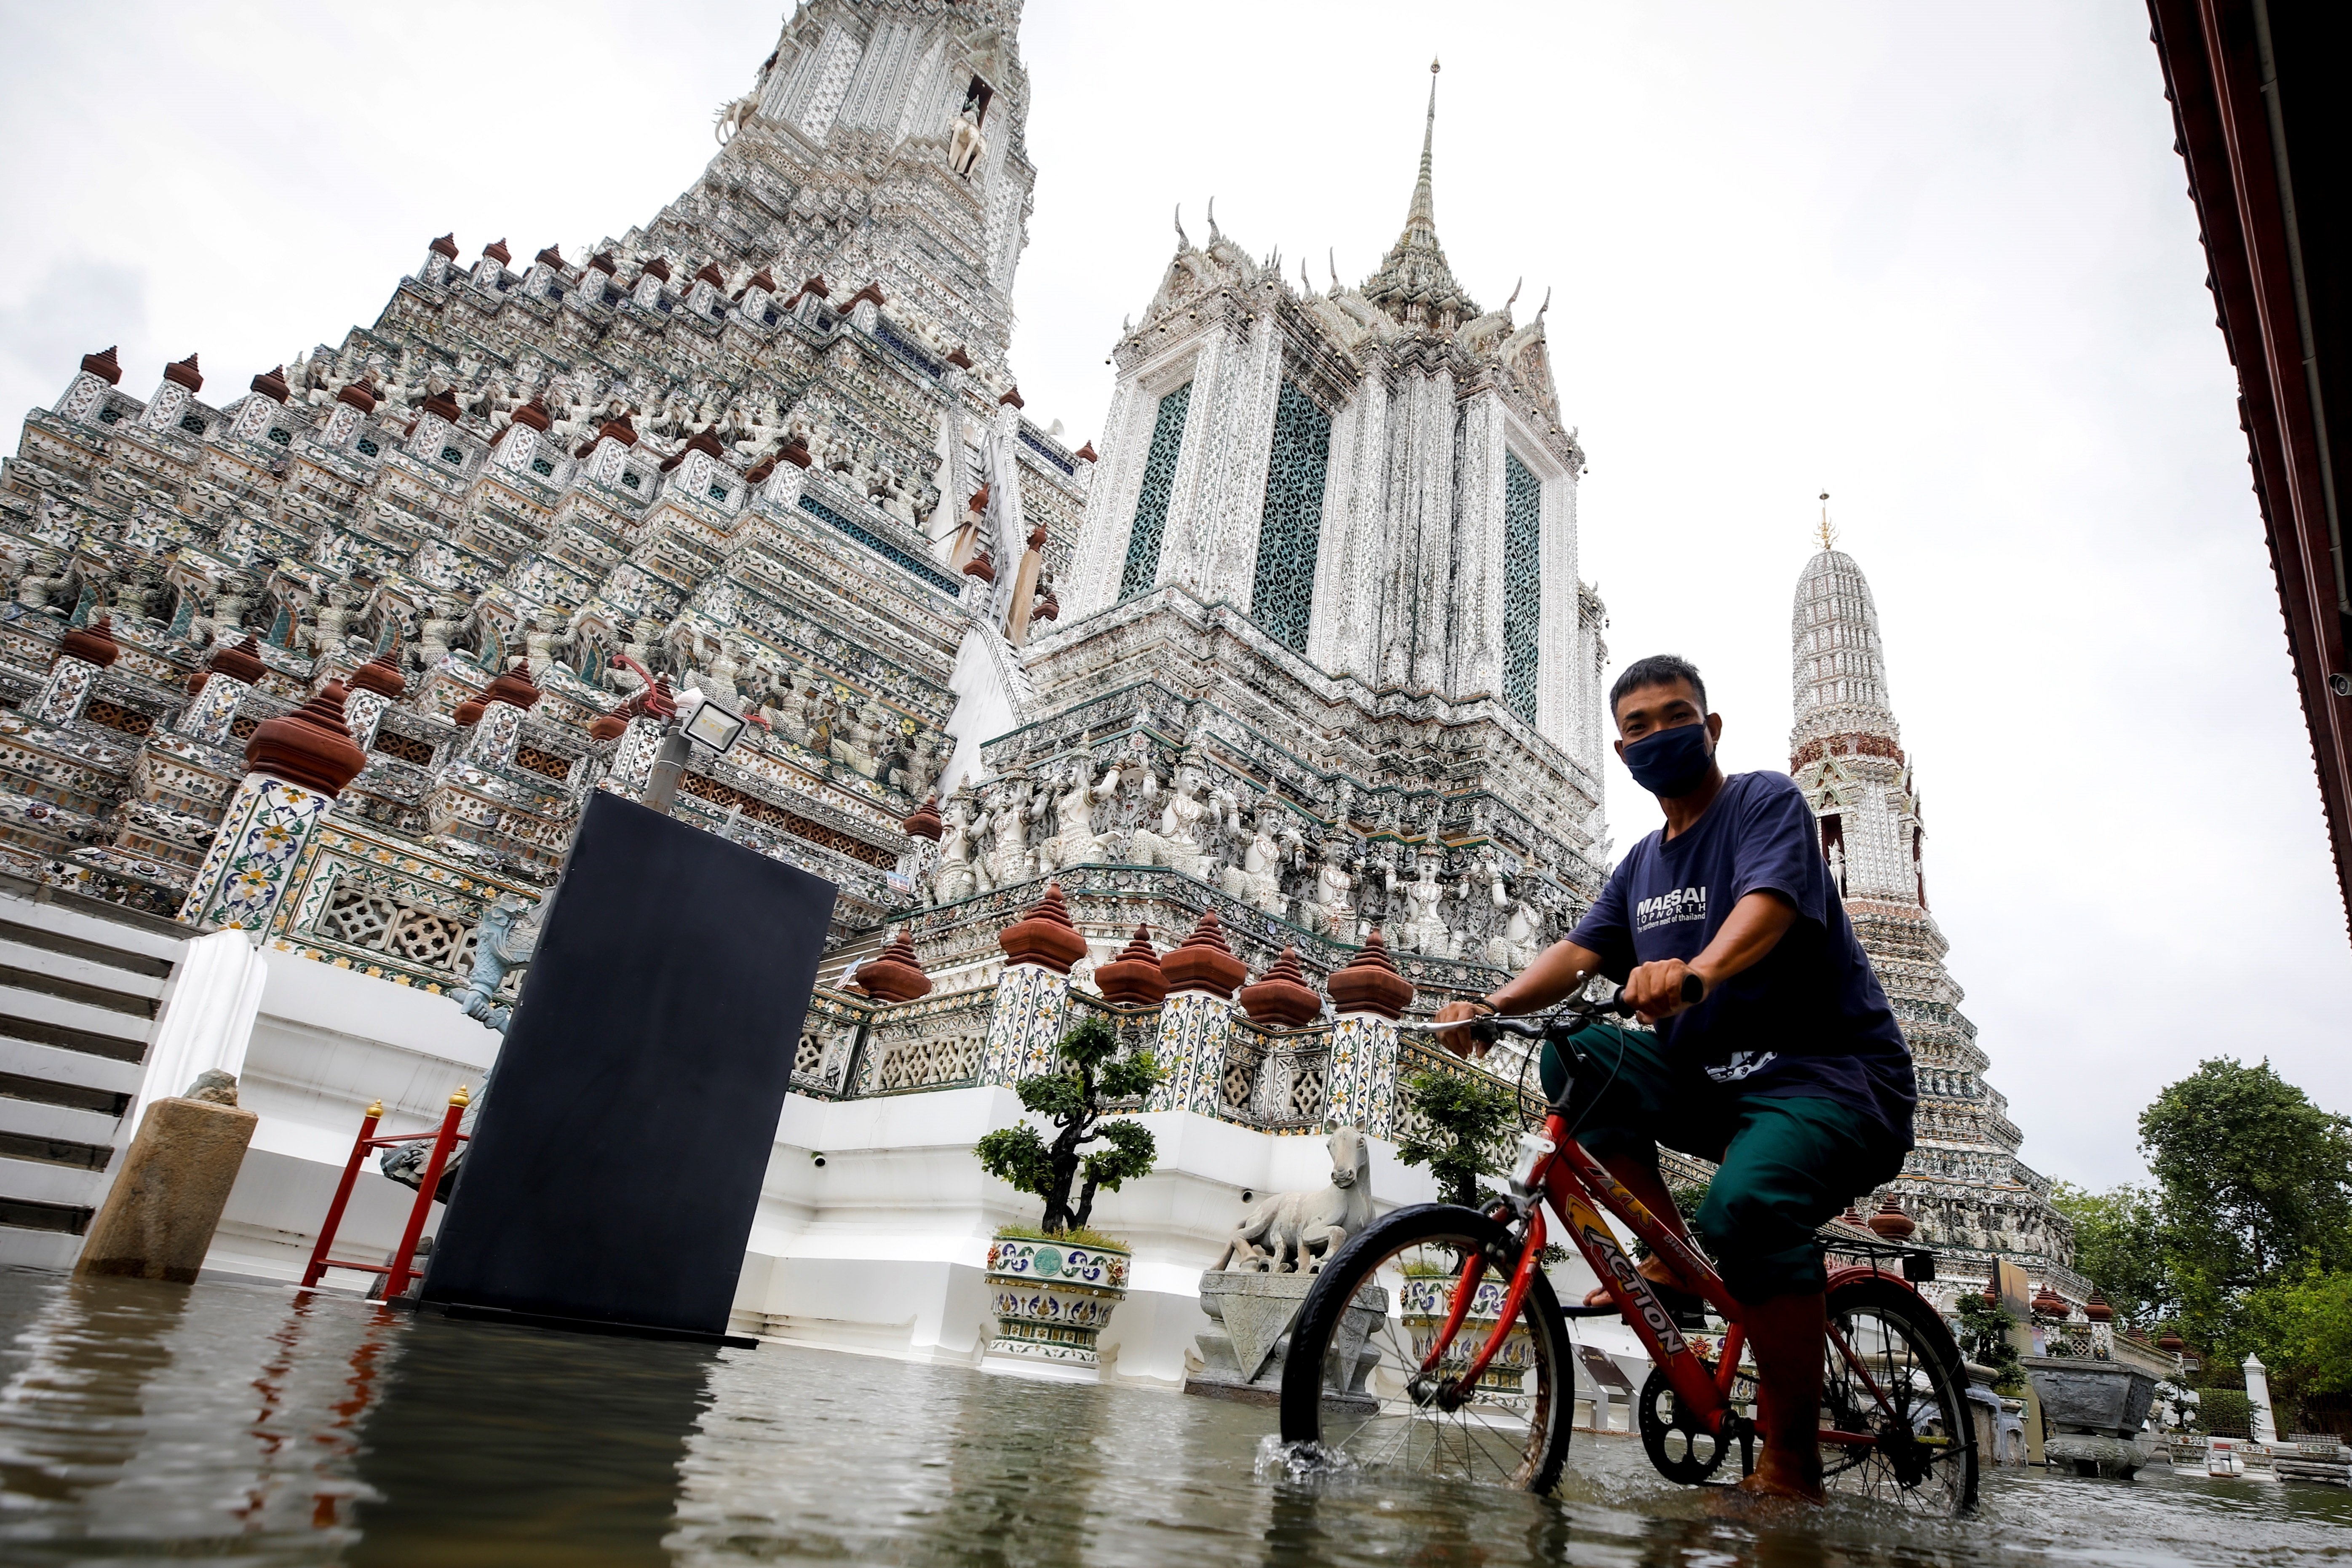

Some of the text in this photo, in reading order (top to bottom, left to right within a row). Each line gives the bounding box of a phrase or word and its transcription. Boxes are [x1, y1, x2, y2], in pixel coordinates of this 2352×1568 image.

[1637, 886, 1706, 916] MAESAI
[1643, 920, 1659, 931] northern
[1659, 916, 1671, 926] most
[1671, 914, 1678, 923] of
[1678, 912, 1706, 922] thailand
[1663, 1234, 1706, 1276] Bicycle
[1588, 1231, 1684, 1354] ACTION
